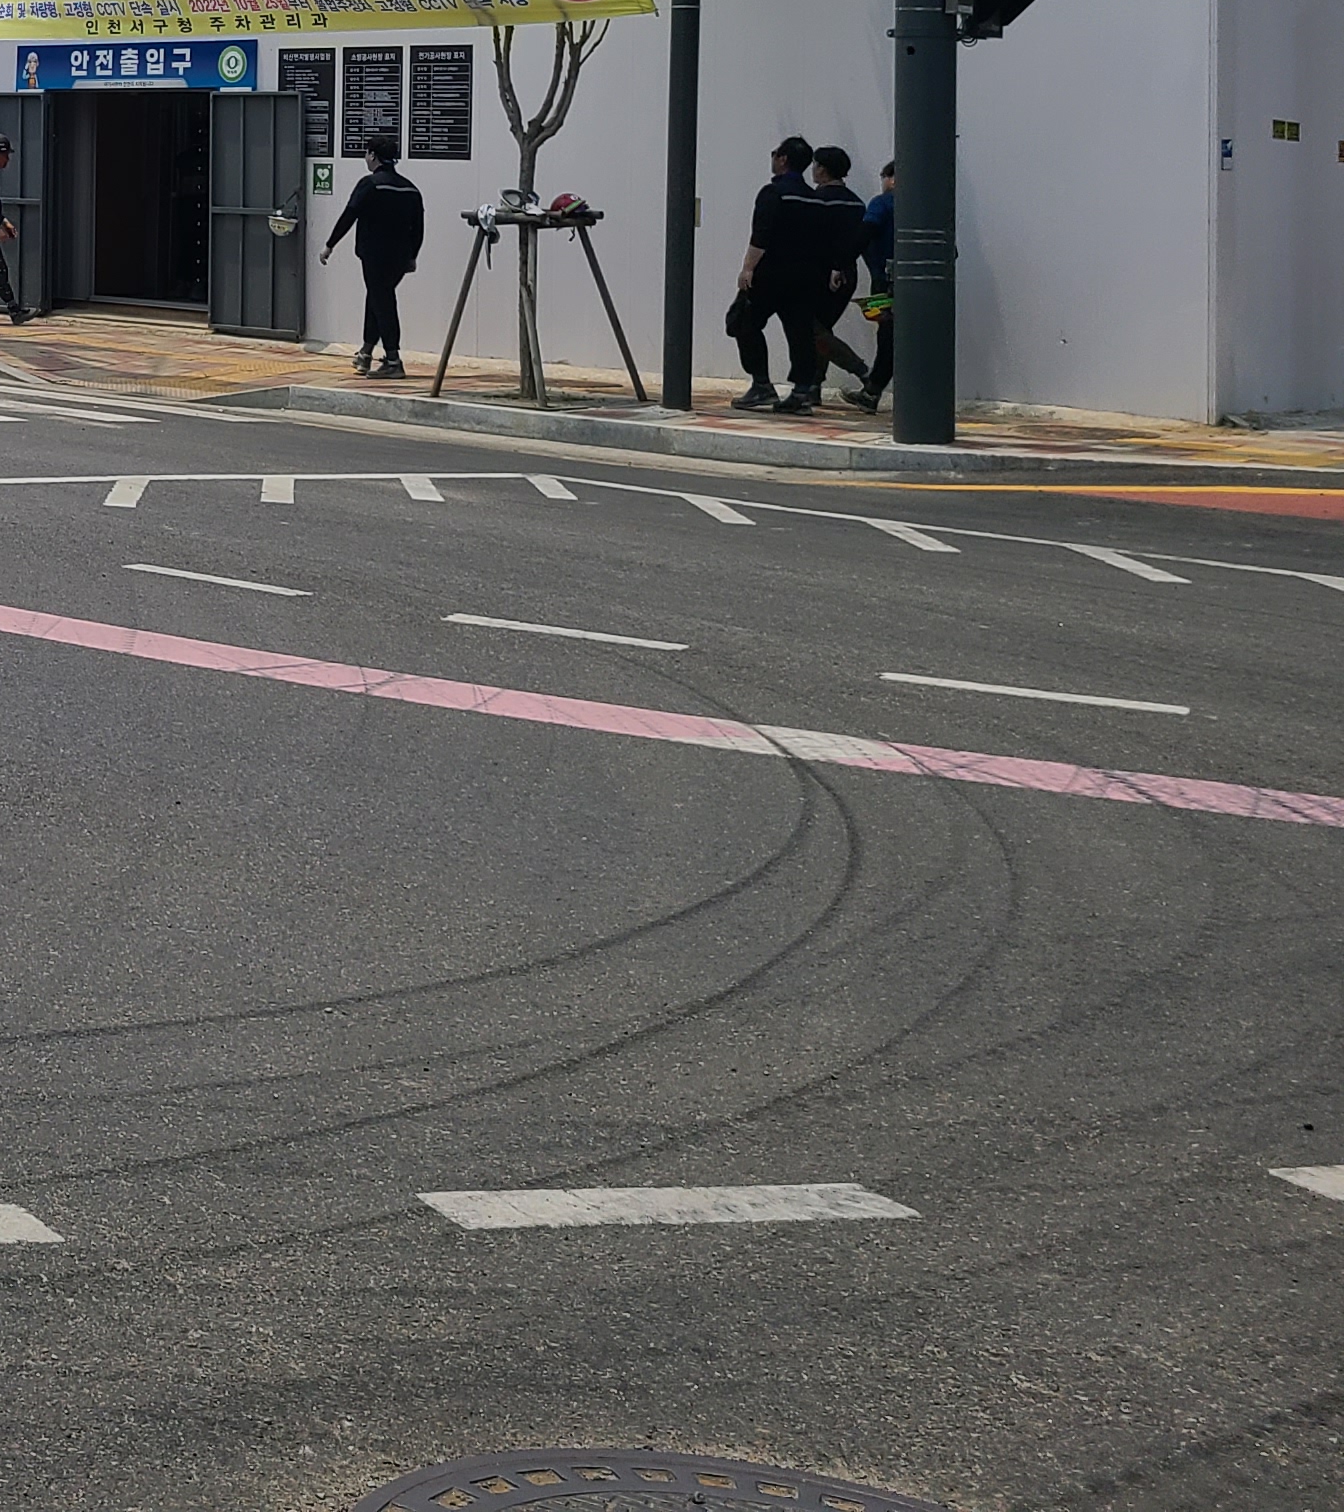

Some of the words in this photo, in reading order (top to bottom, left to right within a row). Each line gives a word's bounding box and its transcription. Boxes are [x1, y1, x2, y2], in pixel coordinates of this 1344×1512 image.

[17, 2, 26, 18] 및
[64, 2, 92, 18] 고정형
[96, 1, 126, 17] CCTV
[129, 0, 153, 17] 단속
[156, 0, 181, 17] 실시
[70, 47, 192, 77] 안전출입구
